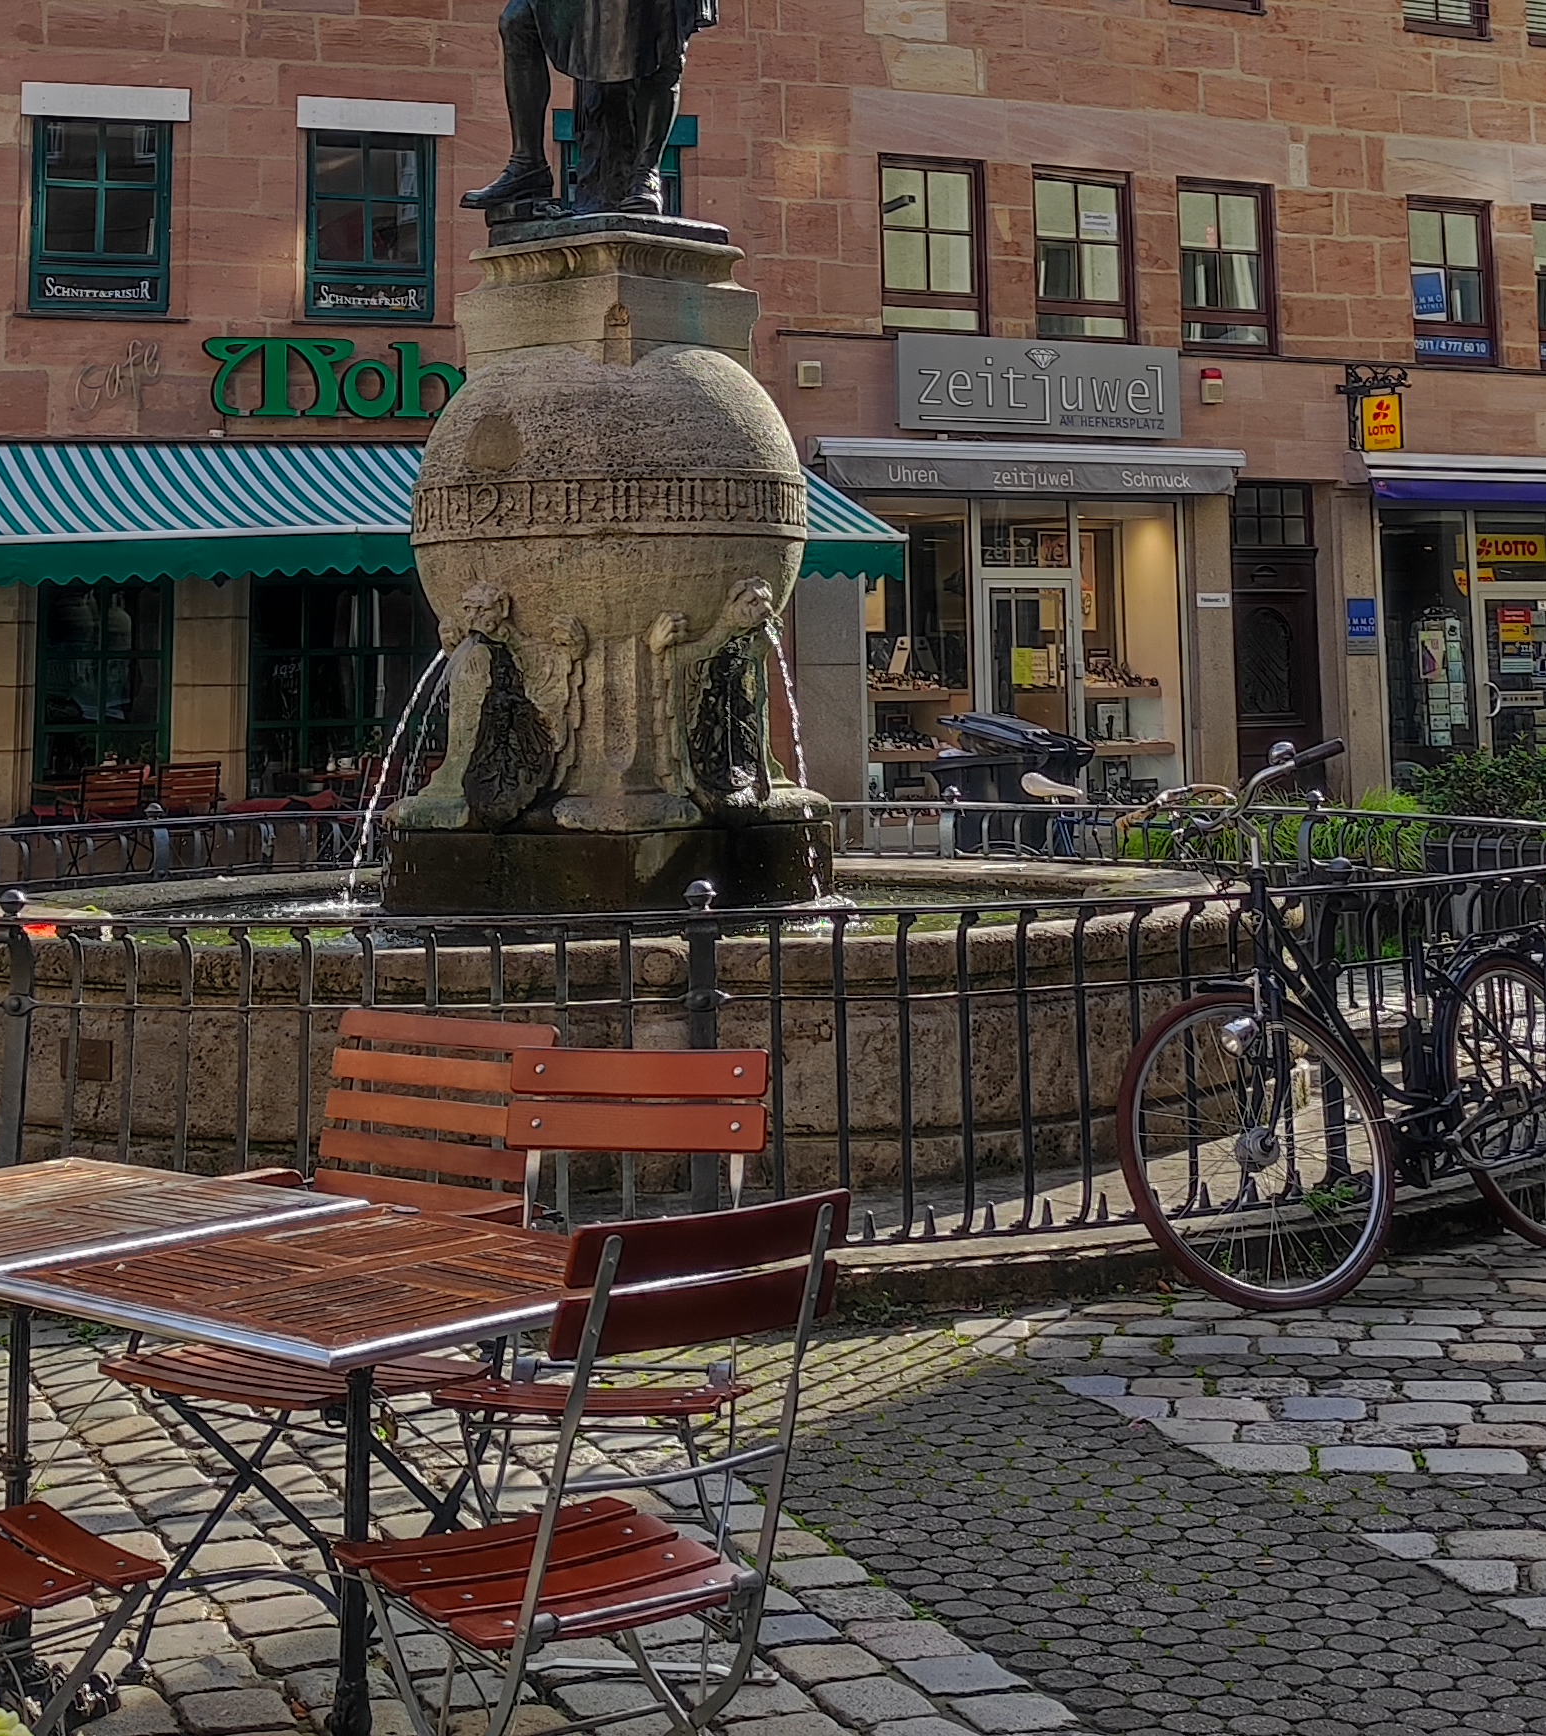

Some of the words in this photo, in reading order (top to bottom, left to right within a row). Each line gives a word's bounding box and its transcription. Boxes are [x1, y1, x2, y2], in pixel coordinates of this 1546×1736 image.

[1414, 294, 1443, 304] IMMO
[202, 336, 466, 418] Moh
[1059, 415, 1075, 427] AM
[1080, 415, 1166, 431] HEFNERSPLATZ
[1368, 424, 1396, 436] LOTTO
[887, 464, 939, 484] Uhren
[1121, 470, 1192, 489] Schmuck
[1494, 540, 1538, 556] LOTTO
[1347, 617, 1375, 626] IMMO
